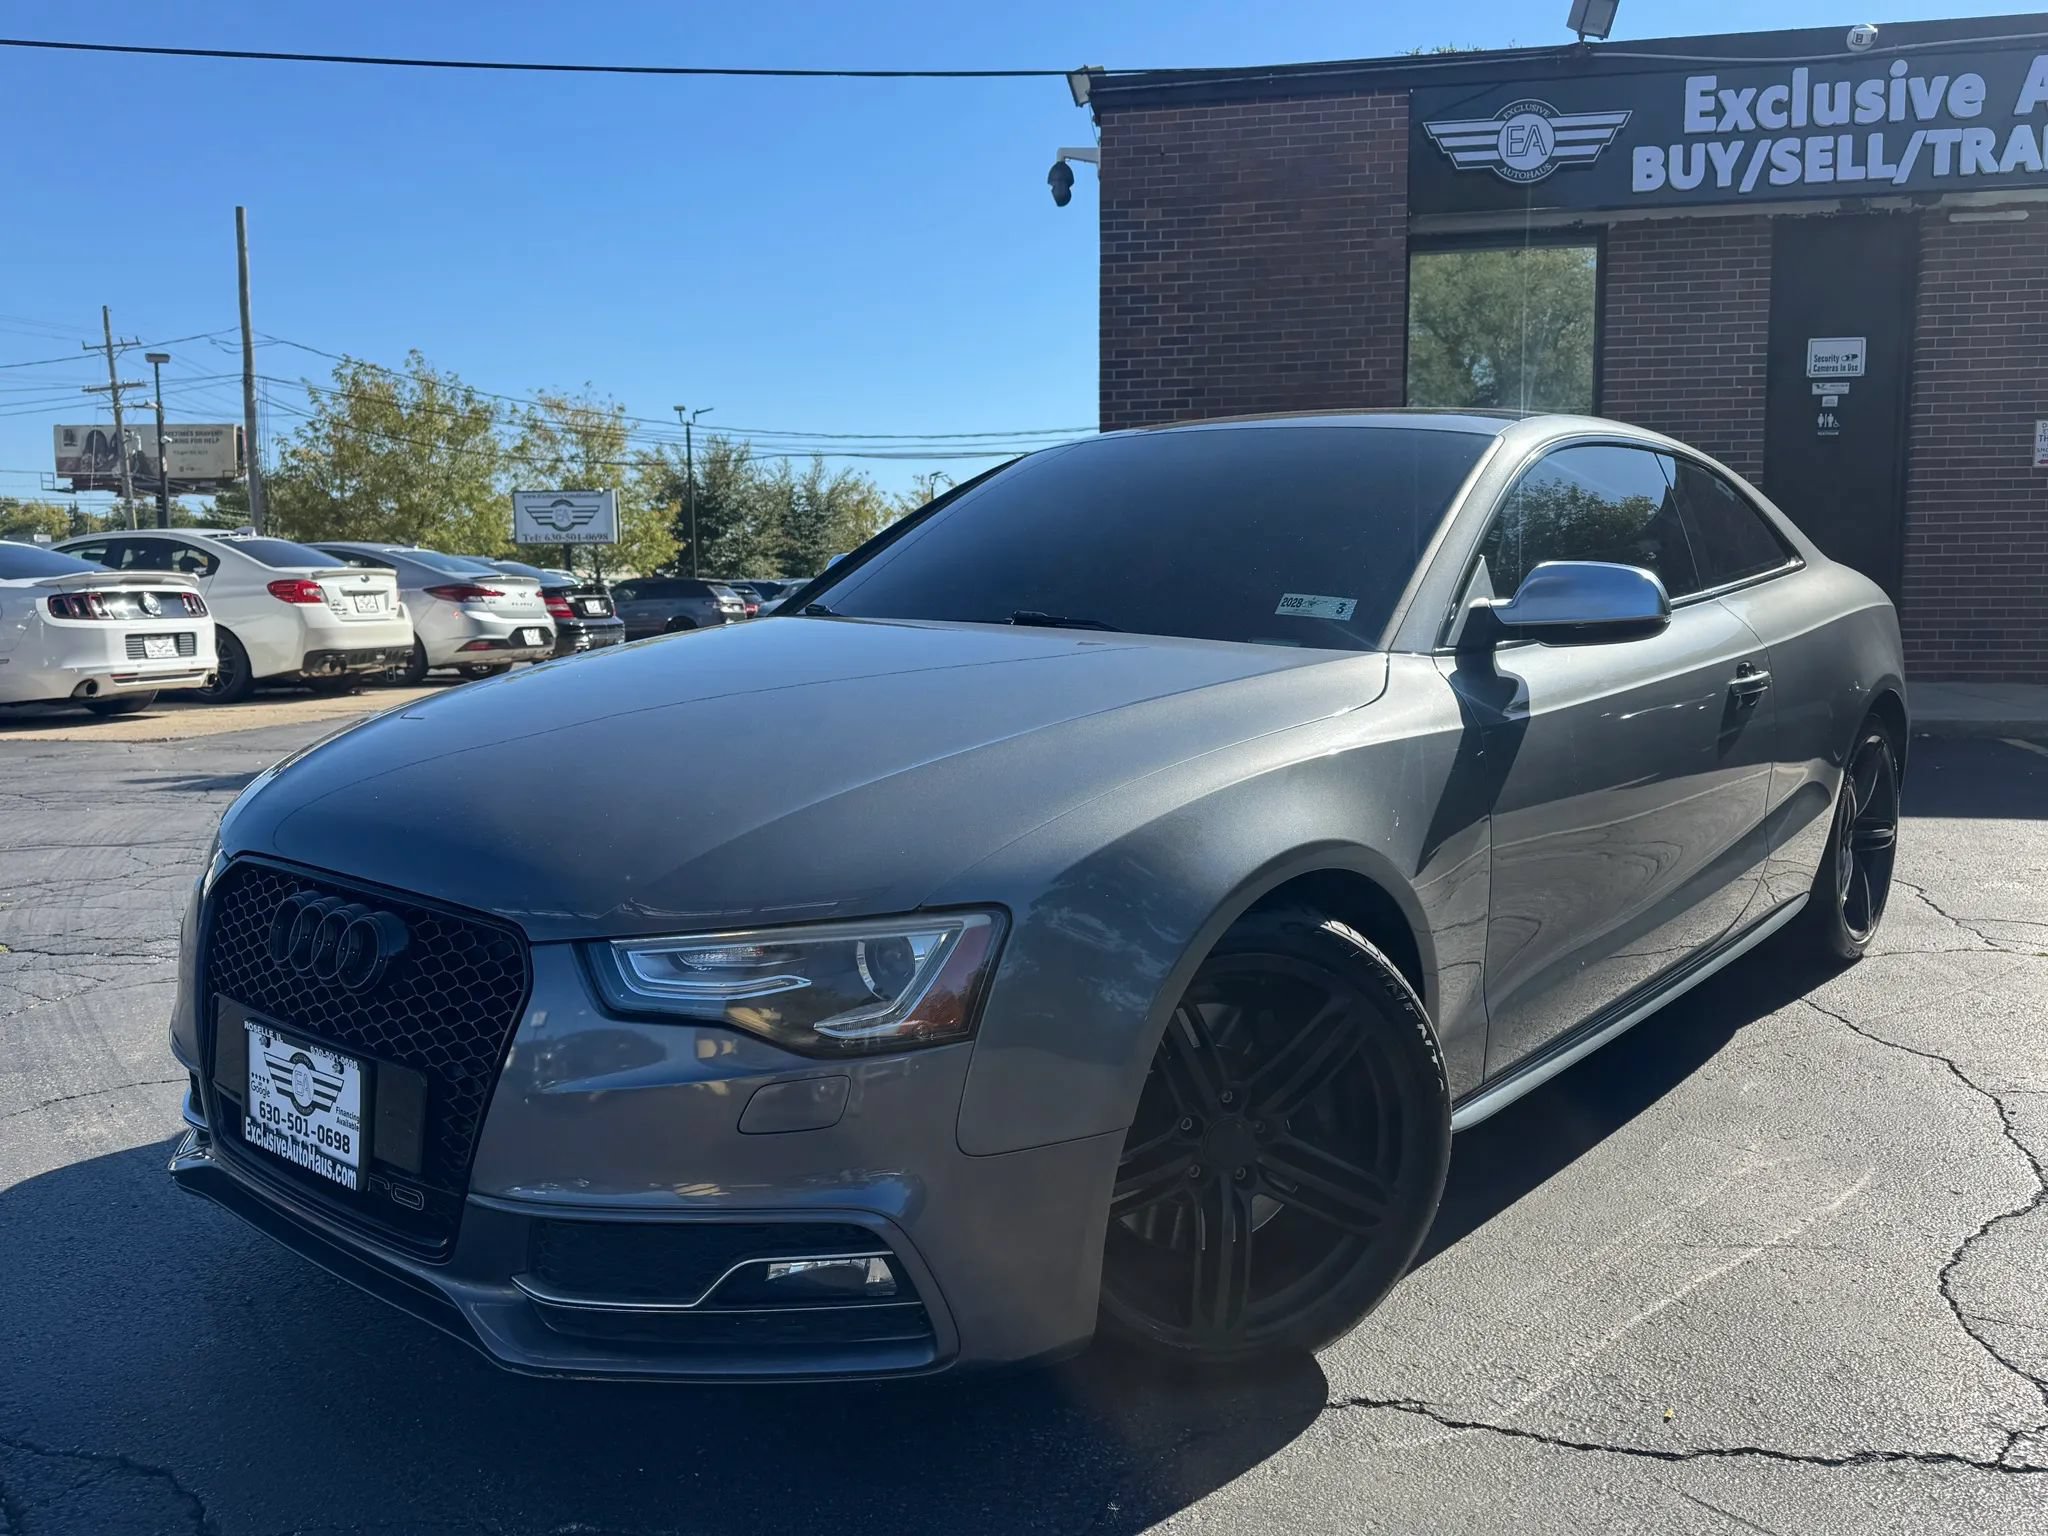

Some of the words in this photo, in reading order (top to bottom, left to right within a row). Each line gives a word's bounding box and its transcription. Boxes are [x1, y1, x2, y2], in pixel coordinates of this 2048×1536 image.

[1684, 59, 1986, 134] Exclusive
[1503, 104, 1551, 120] EXCLUSIVE
[1506, 124, 1548, 158] EA
[1632, 124, 2048, 193] BUY/SELL/TRA
[1500, 162, 1552, 180] AUTOHAUS
[1813, 363, 1839, 373] Cameras
[1847, 363, 1859, 372] Use
[1814, 354, 1840, 364] Security
[523, 534, 541, 542] Tel:
[544, 532, 609, 541] 630-501-0698
[1335, 603, 1347, 614] 3
[244, 1021, 274, 1039] ROSELLE
[275, 1032, 284, 1042] IL
[250, 1080, 272, 1099] Google
[335, 1106, 360, 1124] Financing
[336, 1116, 360, 1132] Available
[259, 1100, 351, 1154] 630-501-0698
[245, 1116, 357, 1190] ExclusiveAutoHaus.com
